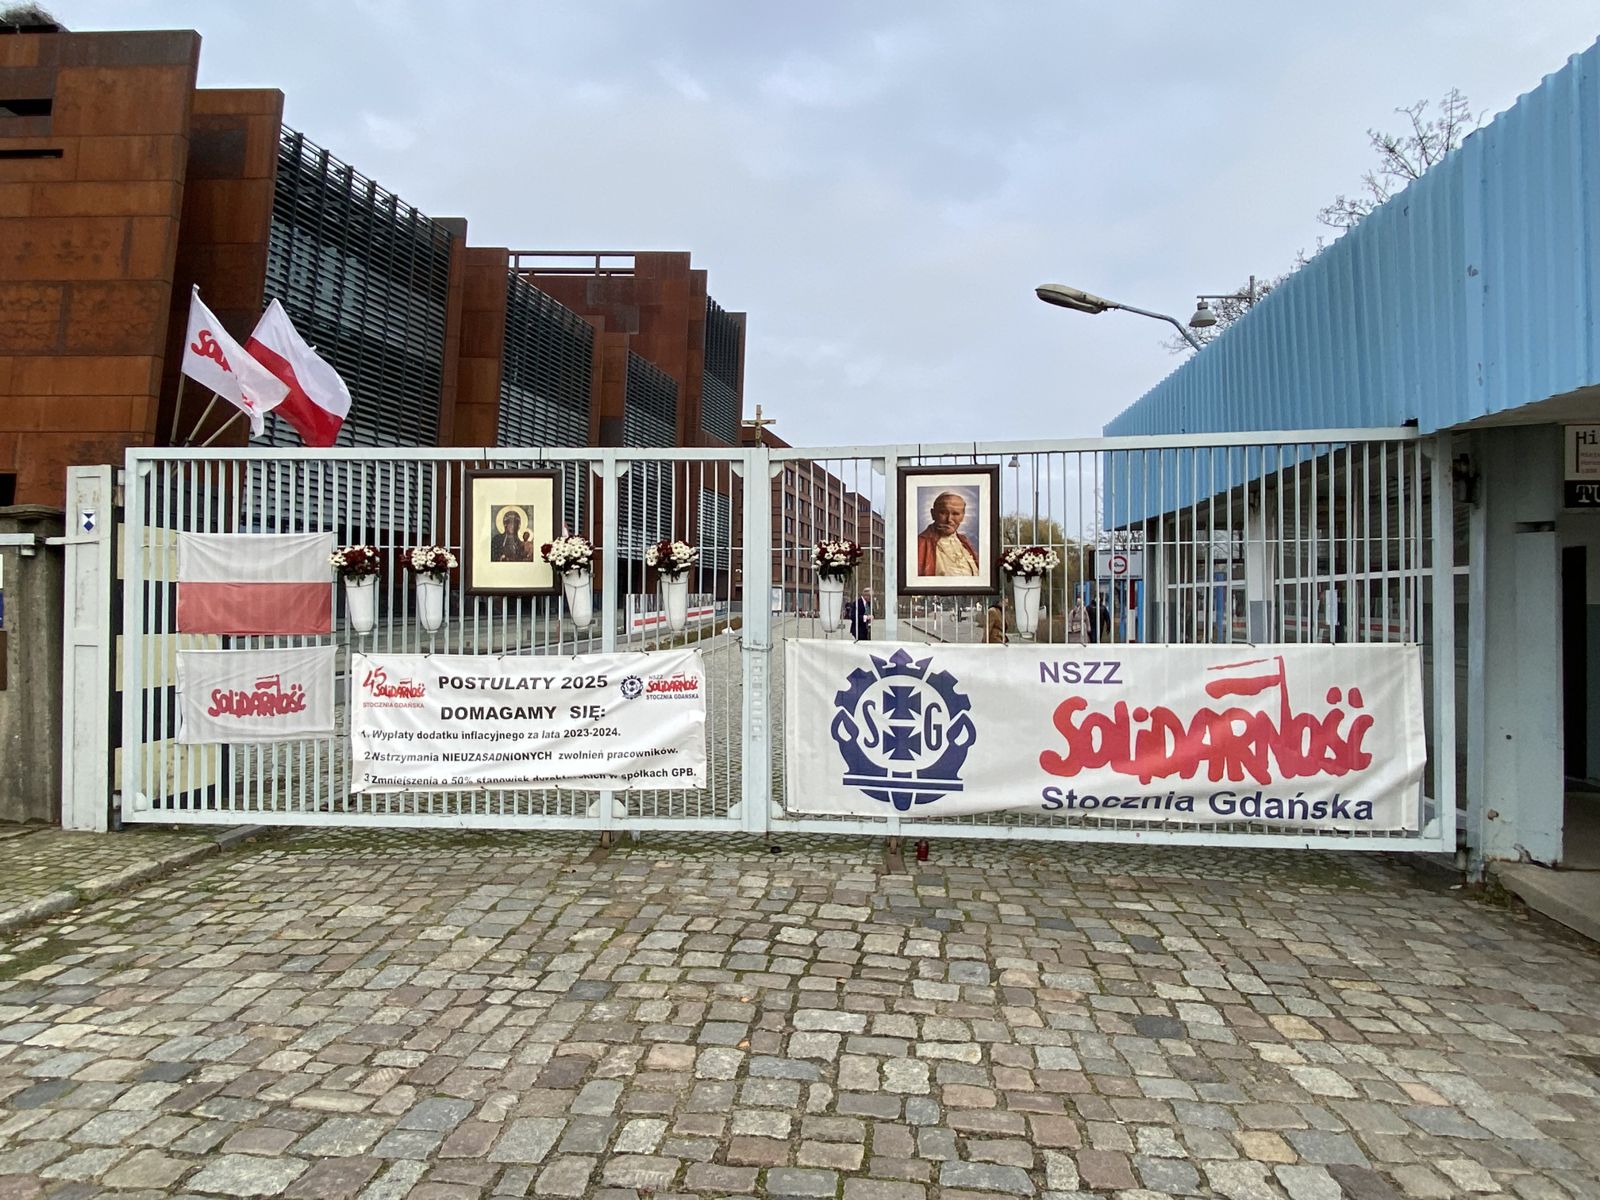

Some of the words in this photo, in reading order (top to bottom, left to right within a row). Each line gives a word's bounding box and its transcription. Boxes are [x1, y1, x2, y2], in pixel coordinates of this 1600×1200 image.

[1039, 661, 1123, 685] NSZZ
[438, 675, 556, 690] POSTULATY
[561, 675, 608, 690] 2025
[441, 706, 557, 721] DOMAGAMY
[570, 705, 606, 721] SIĘ:
[417, 730, 459, 740] dodatku
[461, 730, 525, 741] inflacyjnego
[542, 730, 560, 739] lata
[564, 727, 621, 738] 2023-2024.
[442, 751, 552, 762] NIEUZASADNIONYCH
[558, 750, 604, 760] zwolnień
[607, 747, 679, 762] pracowników.
[371, 775, 438, 786] Zmniejszenia
[671, 767, 697, 777] GPB.
[1042, 786, 1195, 813] Stocznia
[1208, 791, 1374, 821] Gdańska
